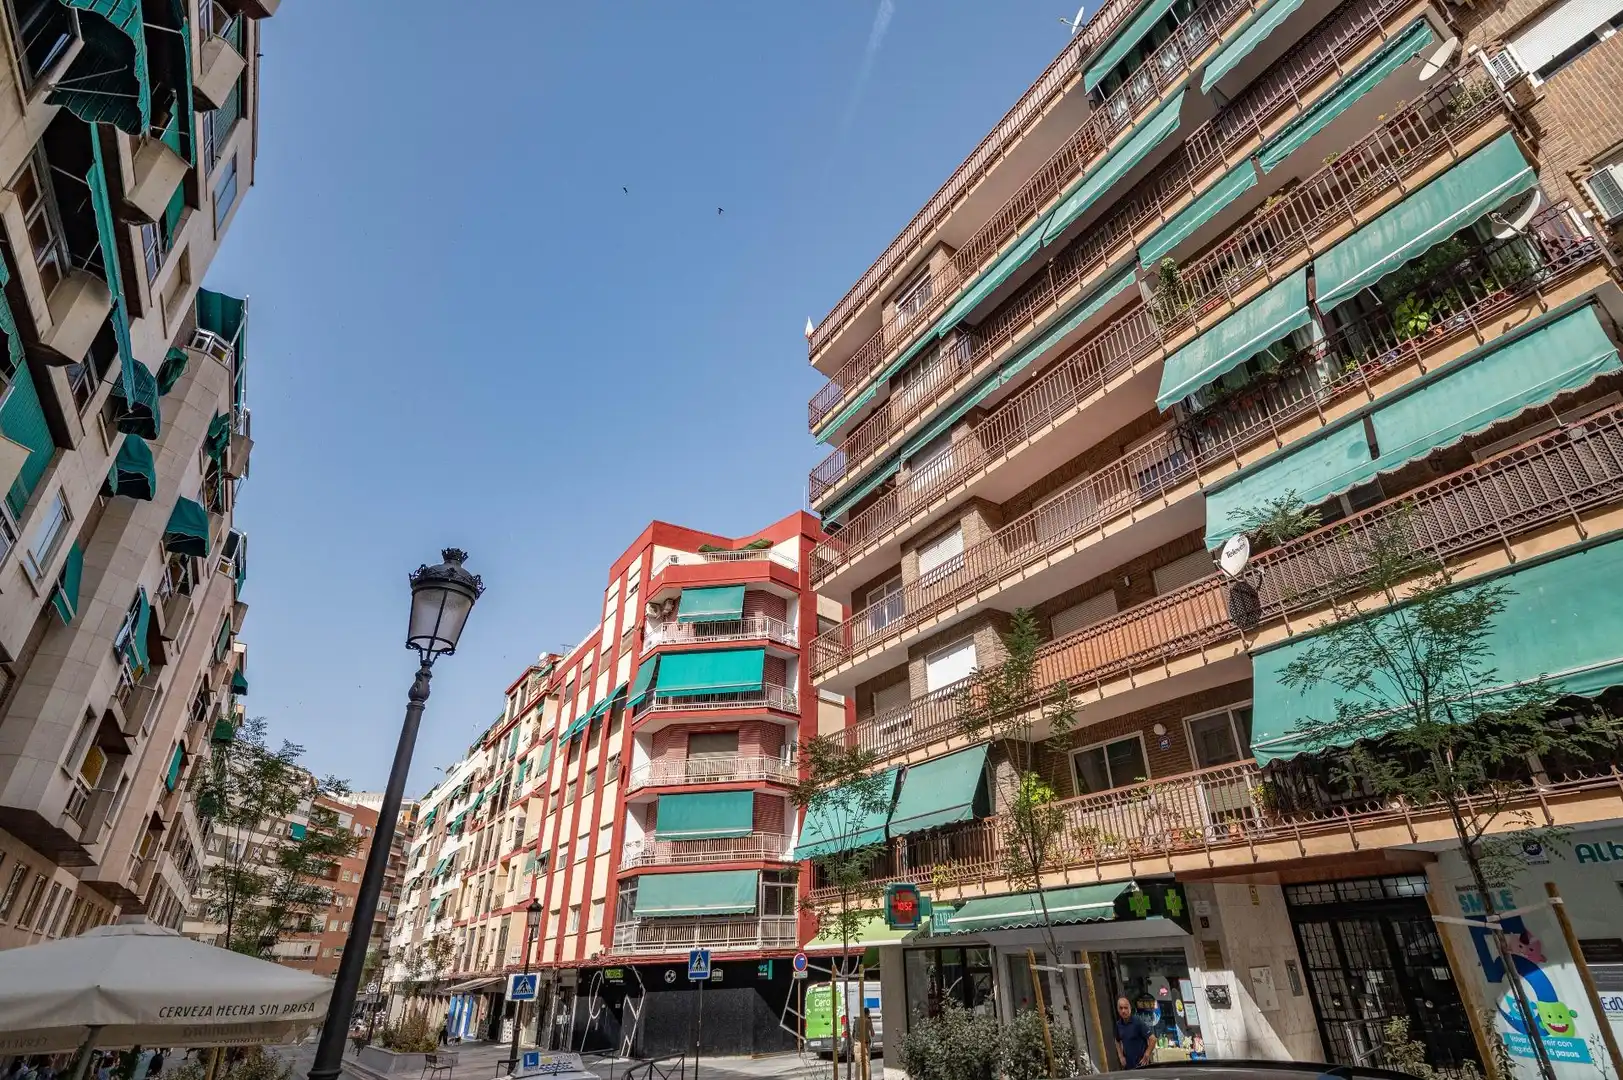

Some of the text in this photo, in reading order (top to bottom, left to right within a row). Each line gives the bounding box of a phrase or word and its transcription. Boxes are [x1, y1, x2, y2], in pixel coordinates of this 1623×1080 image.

[1458, 888, 1517, 913] SMLE
[158, 1002, 315, 1018] CERVEZA HECHA SIN PRISA
[526, 1053, 535, 1066] L
